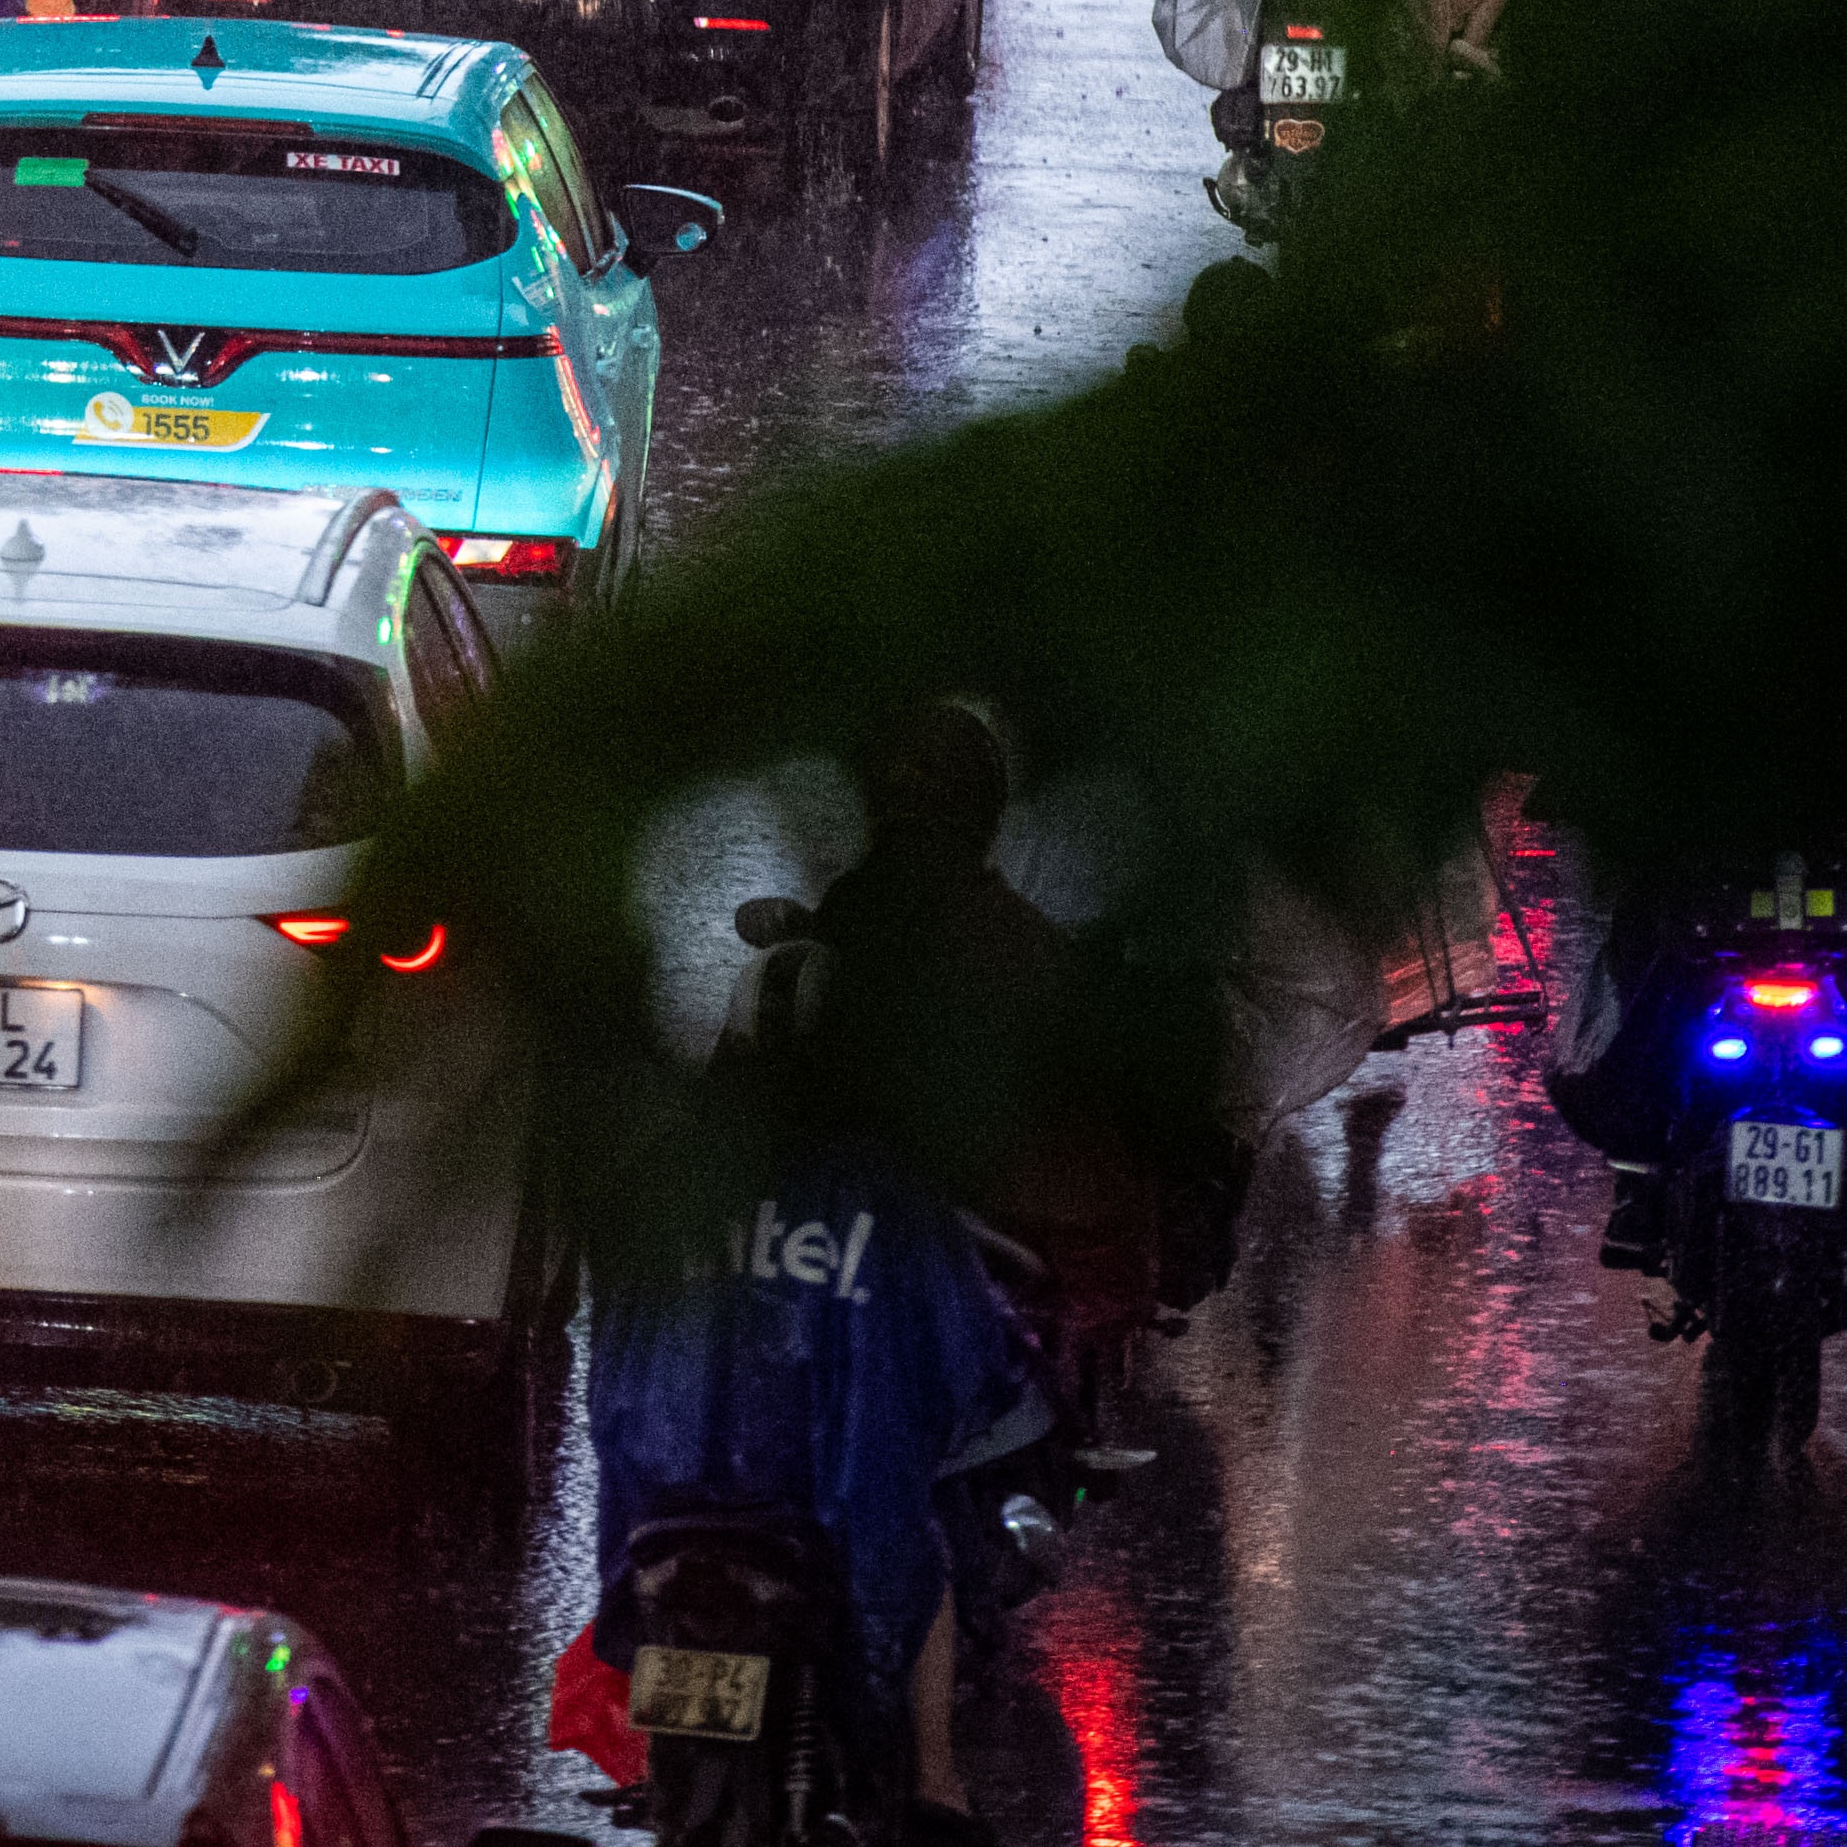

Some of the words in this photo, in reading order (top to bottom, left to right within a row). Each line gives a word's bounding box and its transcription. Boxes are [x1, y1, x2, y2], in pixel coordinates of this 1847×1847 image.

[294, 153, 328, 169] XE
[338, 155, 395, 174] TAXI
[141, 393, 177, 405] BOOK
[180, 395, 215, 408] NOW!
[142, 412, 211, 442] 1555
